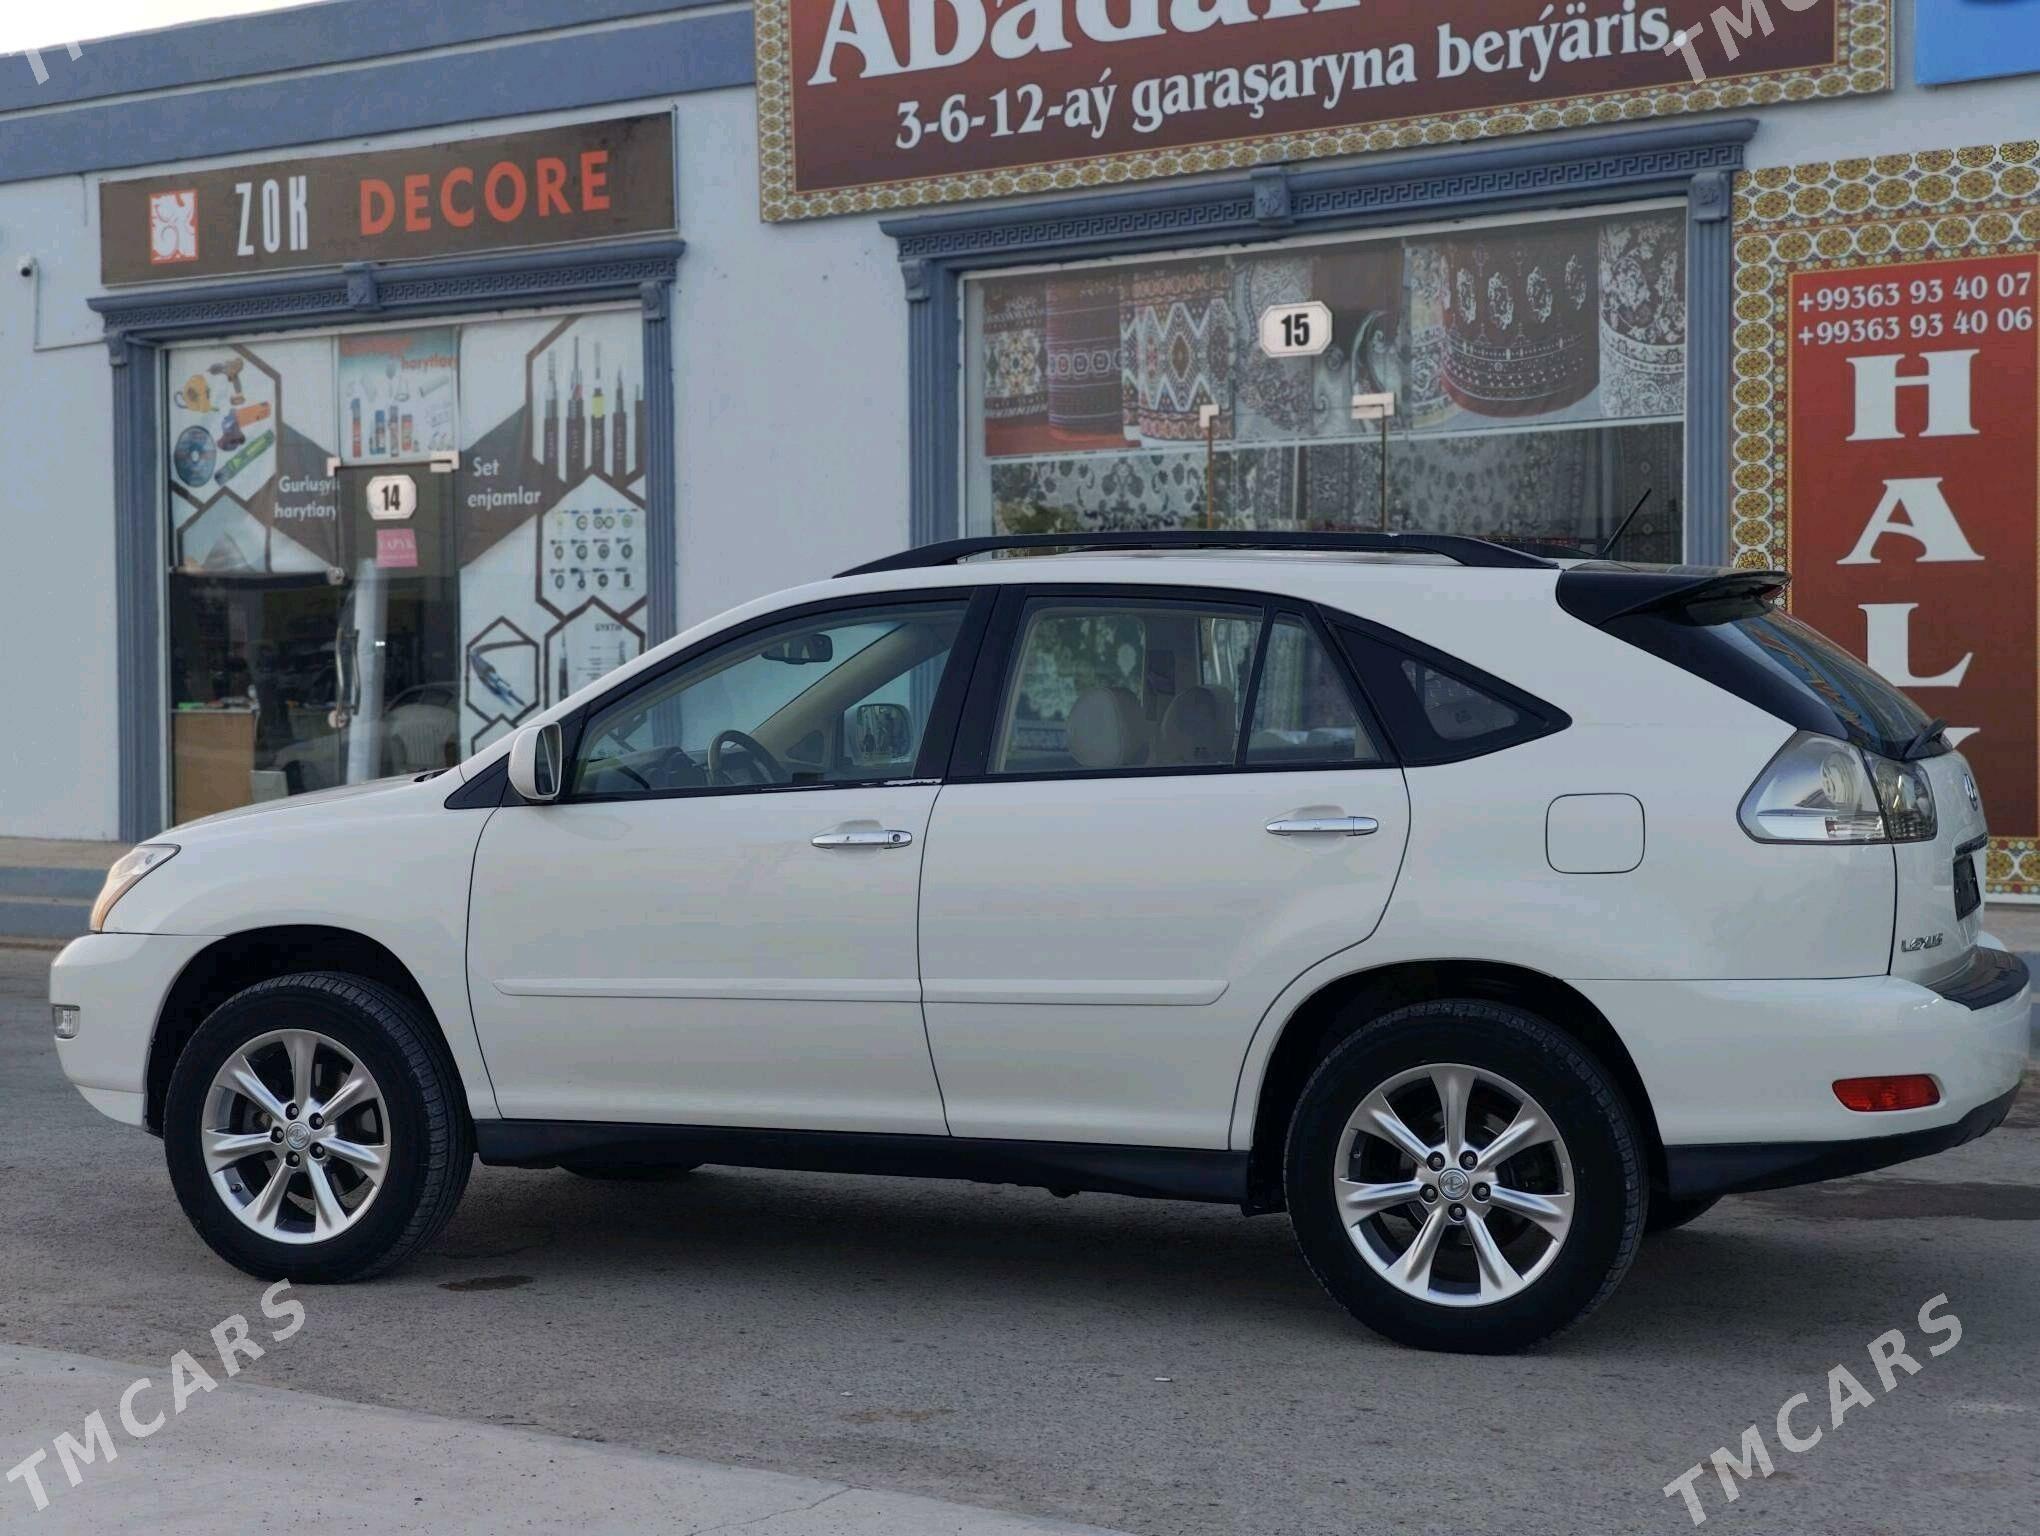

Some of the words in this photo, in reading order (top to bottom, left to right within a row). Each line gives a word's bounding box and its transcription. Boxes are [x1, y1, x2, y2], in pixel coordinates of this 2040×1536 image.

[895, 67, 1117, 149] 3-6-12-aý
[1132, 42, 1417, 133] garaşaryna
[1436, 0, 1687, 83] berýäris.
[234, 175, 308, 257] ZOK
[360, 150, 611, 237] DECORE
[1798, 283, 1900, 313] +99363
[1909, 279, 1944, 305] 93
[1952, 275, 1988, 300] 40
[1997, 272, 2032, 298] 07
[1281, 312, 1310, 347] 15
[1798, 316, 1900, 346] +99363
[1909, 313, 1944, 338] 93
[1952, 309, 1988, 334] 40
[1997, 306, 2033, 332] 06
[472, 456, 500, 477] Set
[381, 484, 400, 511] 14
[467, 485, 542, 511] enjamlar
[1836, 349, 1986, 750] HAL
